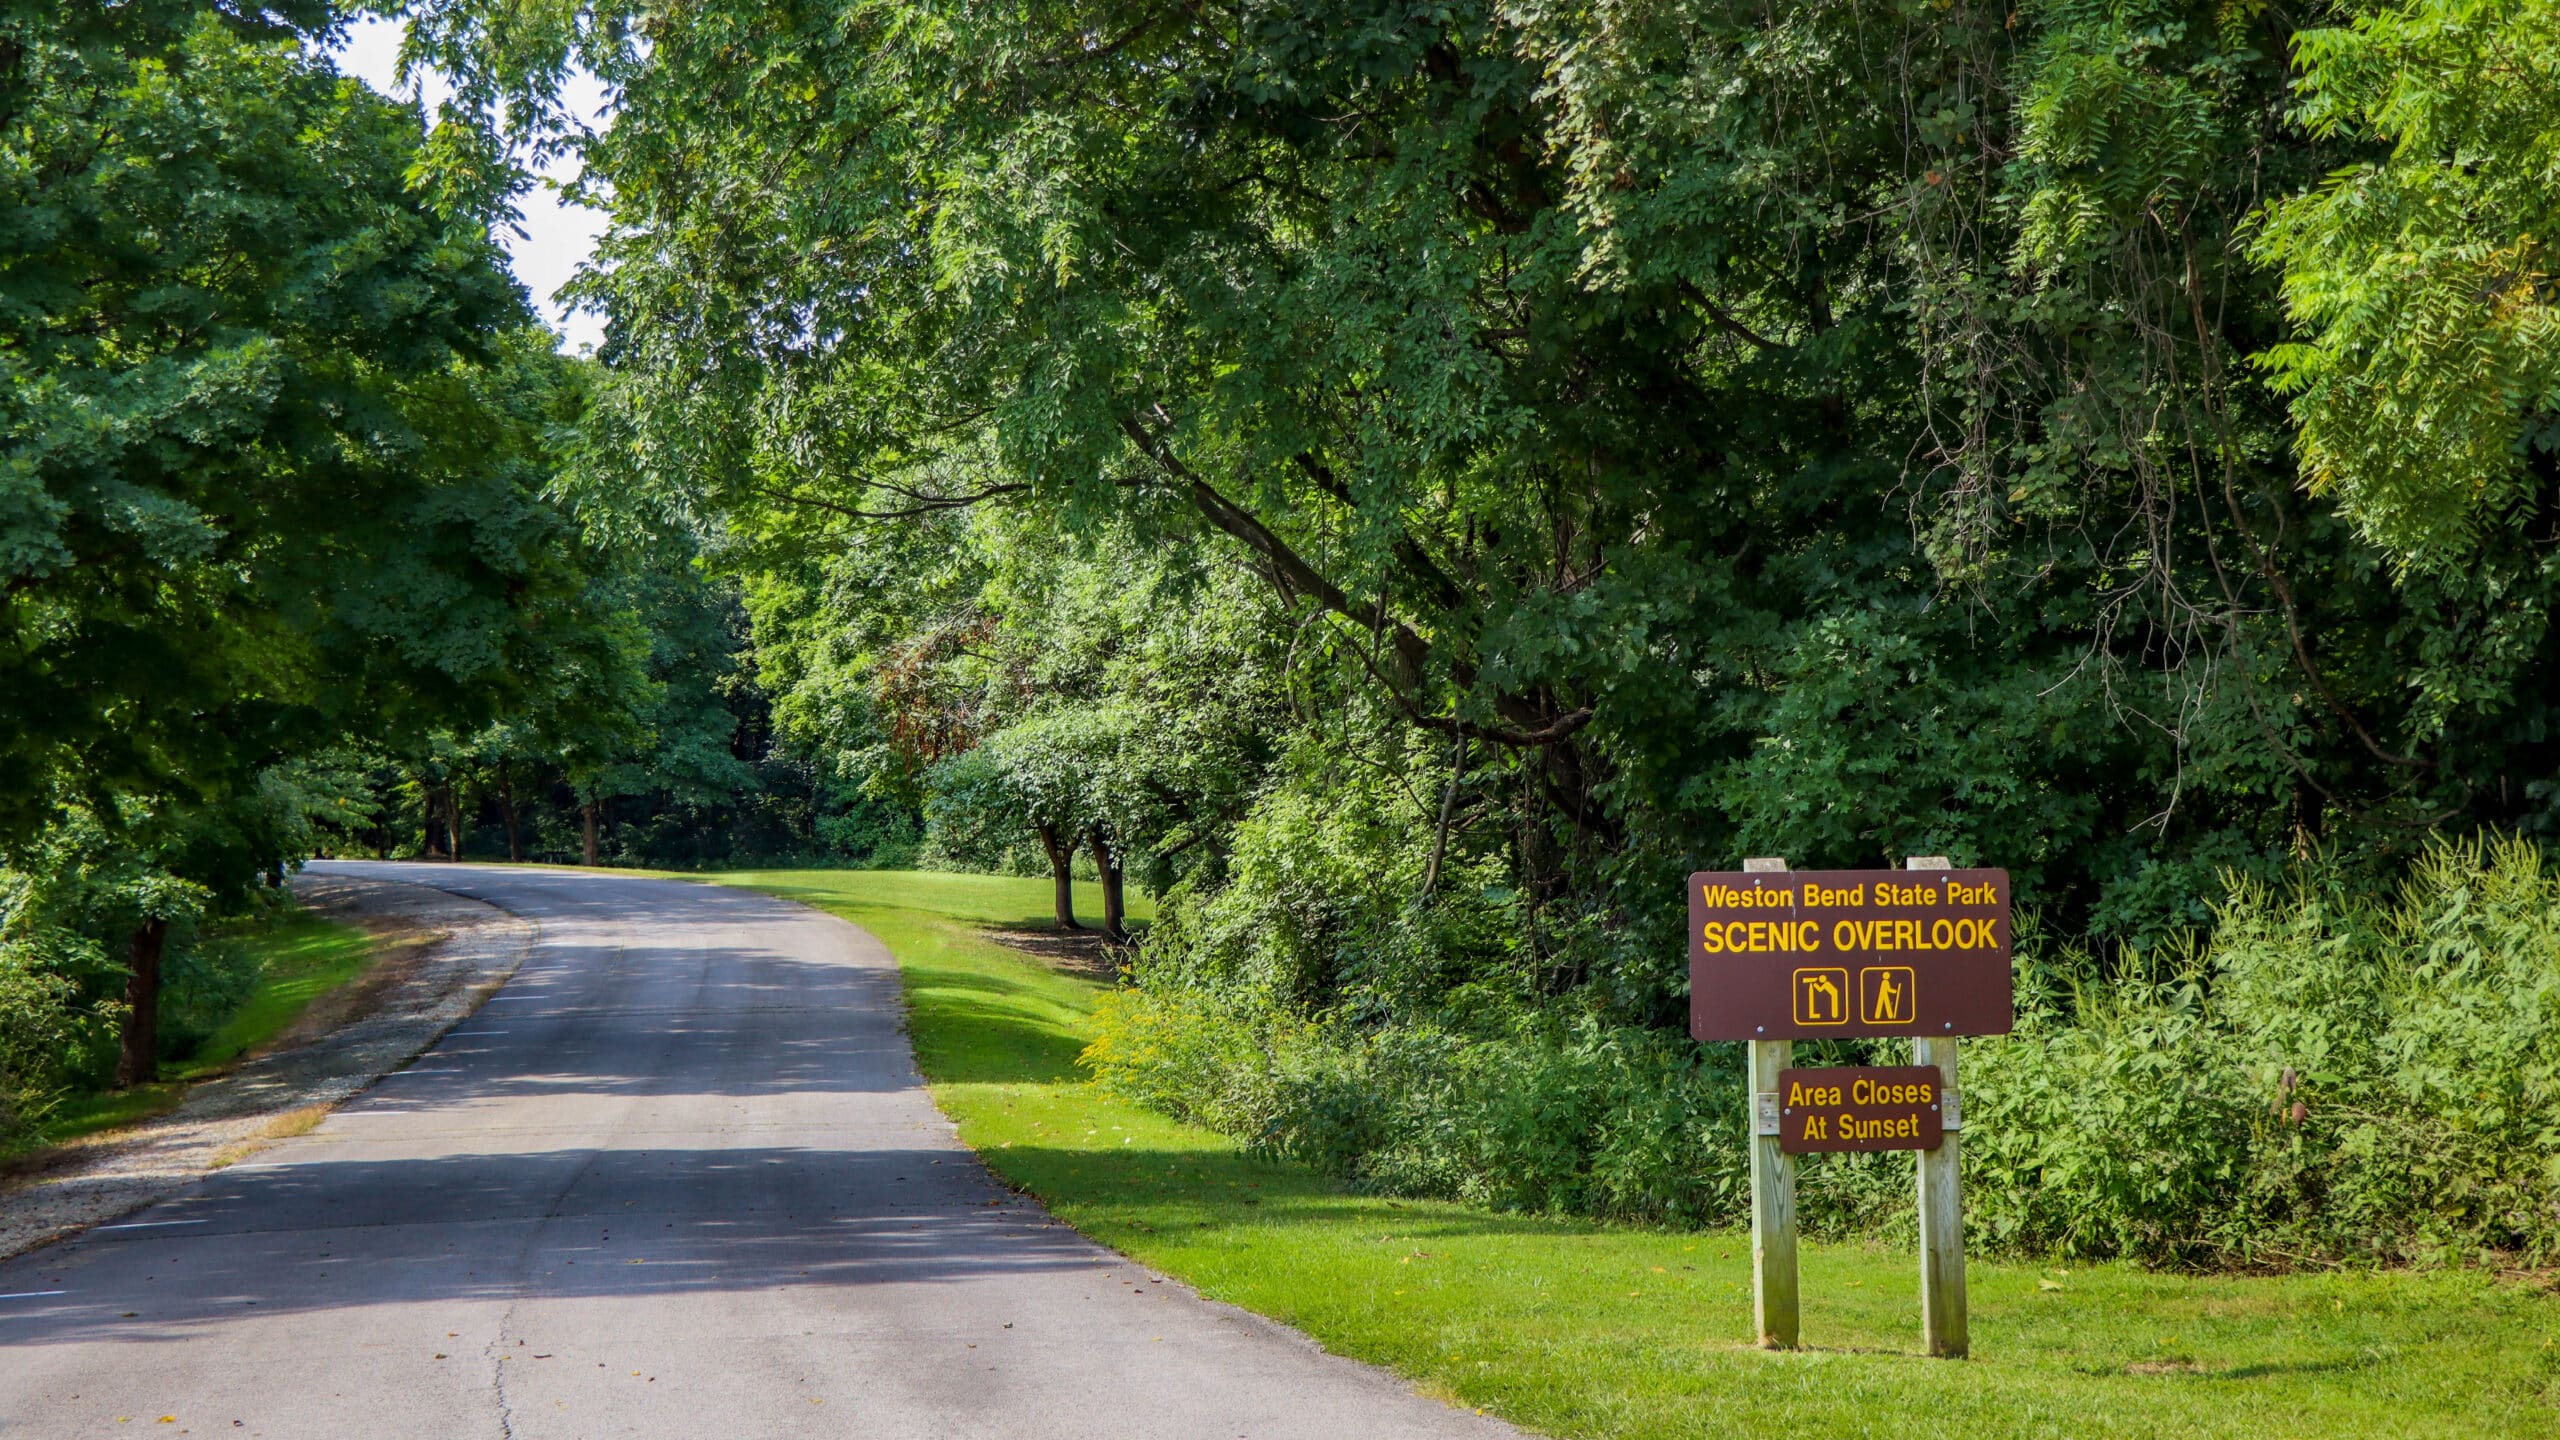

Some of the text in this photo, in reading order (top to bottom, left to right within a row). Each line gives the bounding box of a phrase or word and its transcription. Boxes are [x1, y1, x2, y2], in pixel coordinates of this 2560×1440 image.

[1702, 881, 1998, 909] Weston Bend State Park
[1703, 918, 1998, 954] SCENIC OVERLOOK
[1788, 1079, 1932, 1107] Area Closes
[1803, 1114, 1919, 1140] At Sunset
